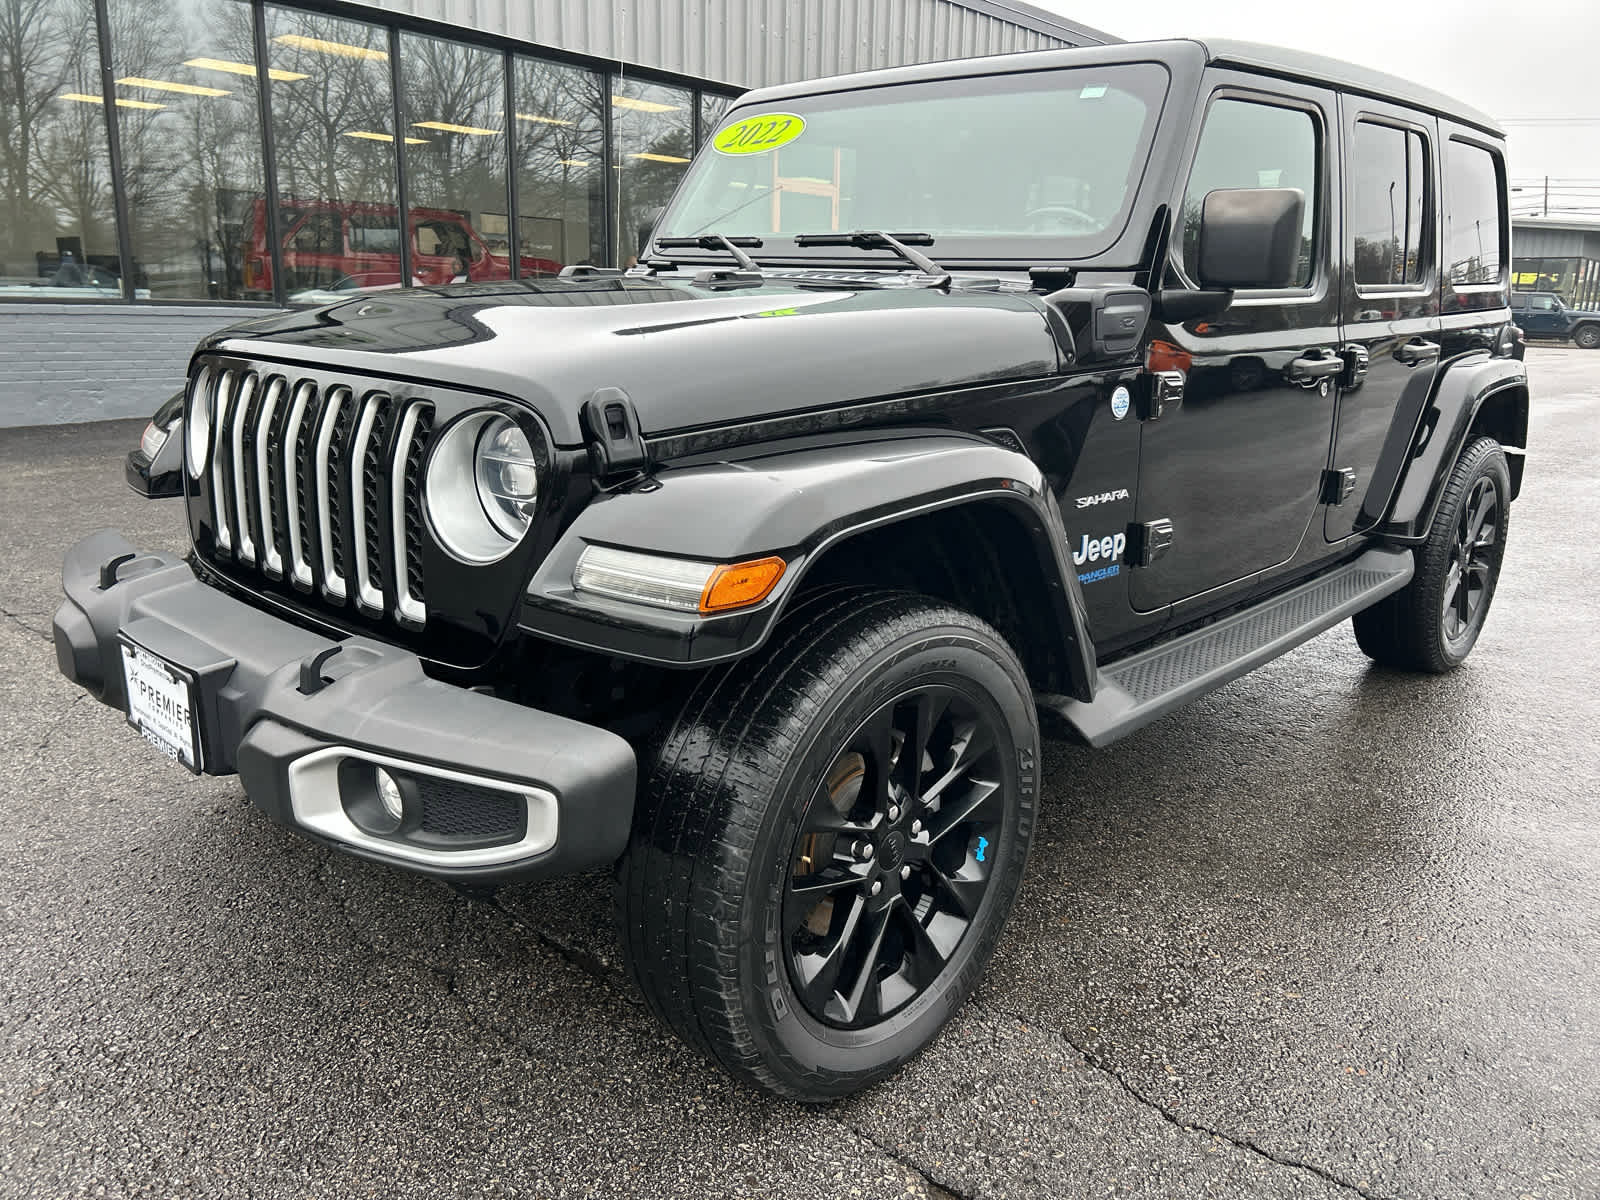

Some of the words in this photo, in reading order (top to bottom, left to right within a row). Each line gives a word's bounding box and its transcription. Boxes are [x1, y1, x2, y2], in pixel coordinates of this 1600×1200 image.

[722, 119, 792, 148] 2022
[1075, 488, 1129, 508] SAHARA
[1072, 532, 1126, 566] Jeep
[1078, 564, 1120, 582] RANGLER
[139, 679, 191, 725] PREMIER
